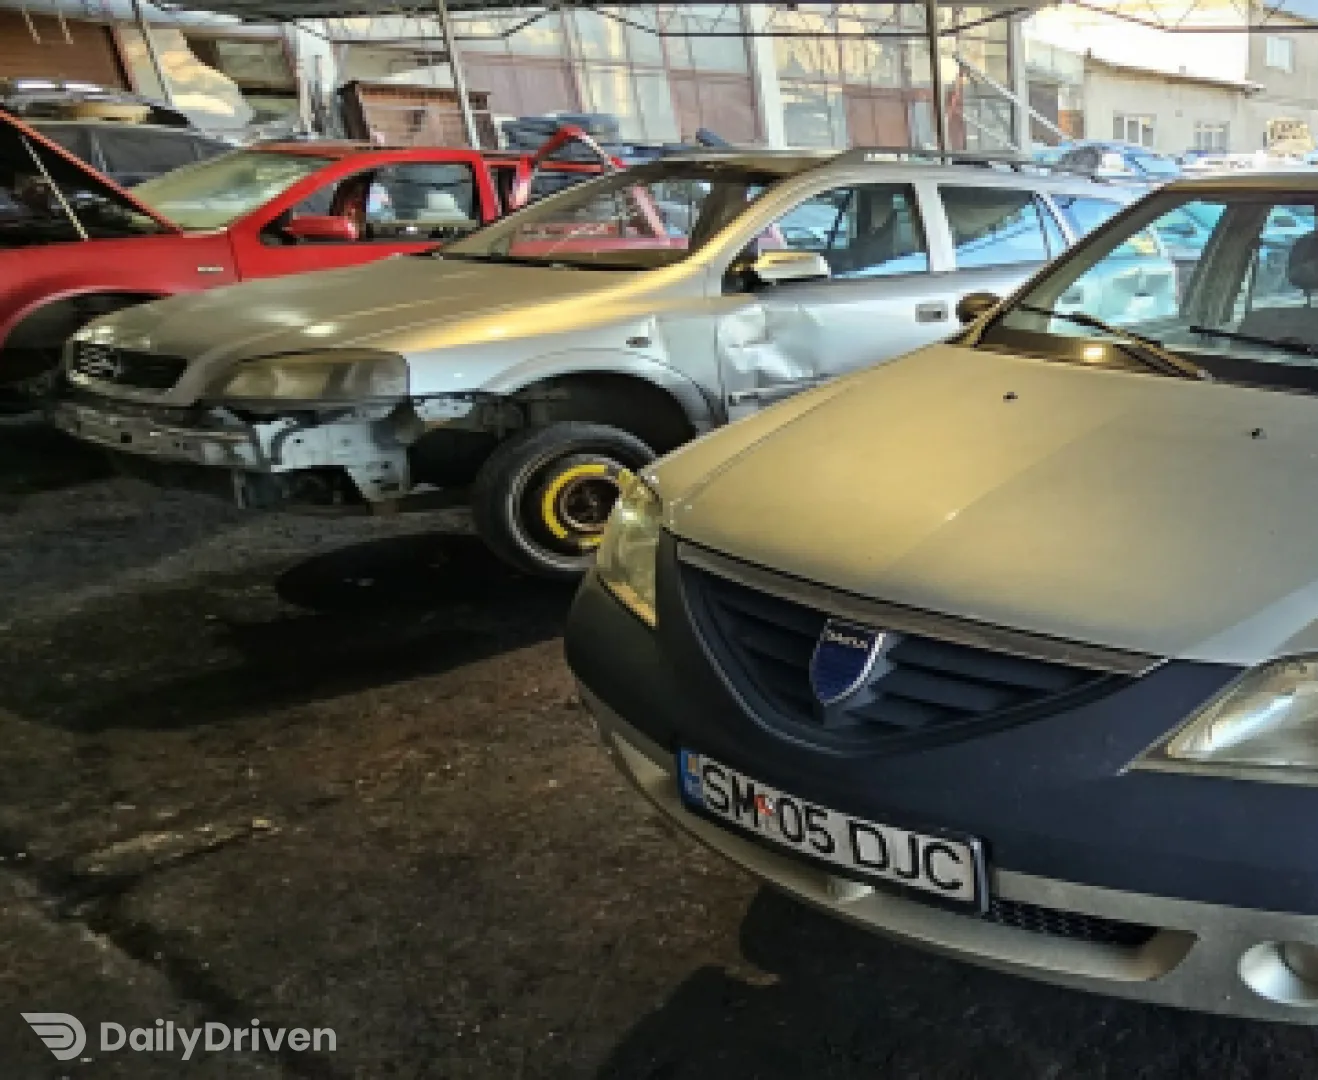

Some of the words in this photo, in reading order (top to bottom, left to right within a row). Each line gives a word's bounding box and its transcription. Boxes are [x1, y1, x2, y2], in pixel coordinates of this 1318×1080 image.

[702, 764, 759, 828] SM
[776, 797, 836, 854] 05
[849, 820, 964, 891] DJC
